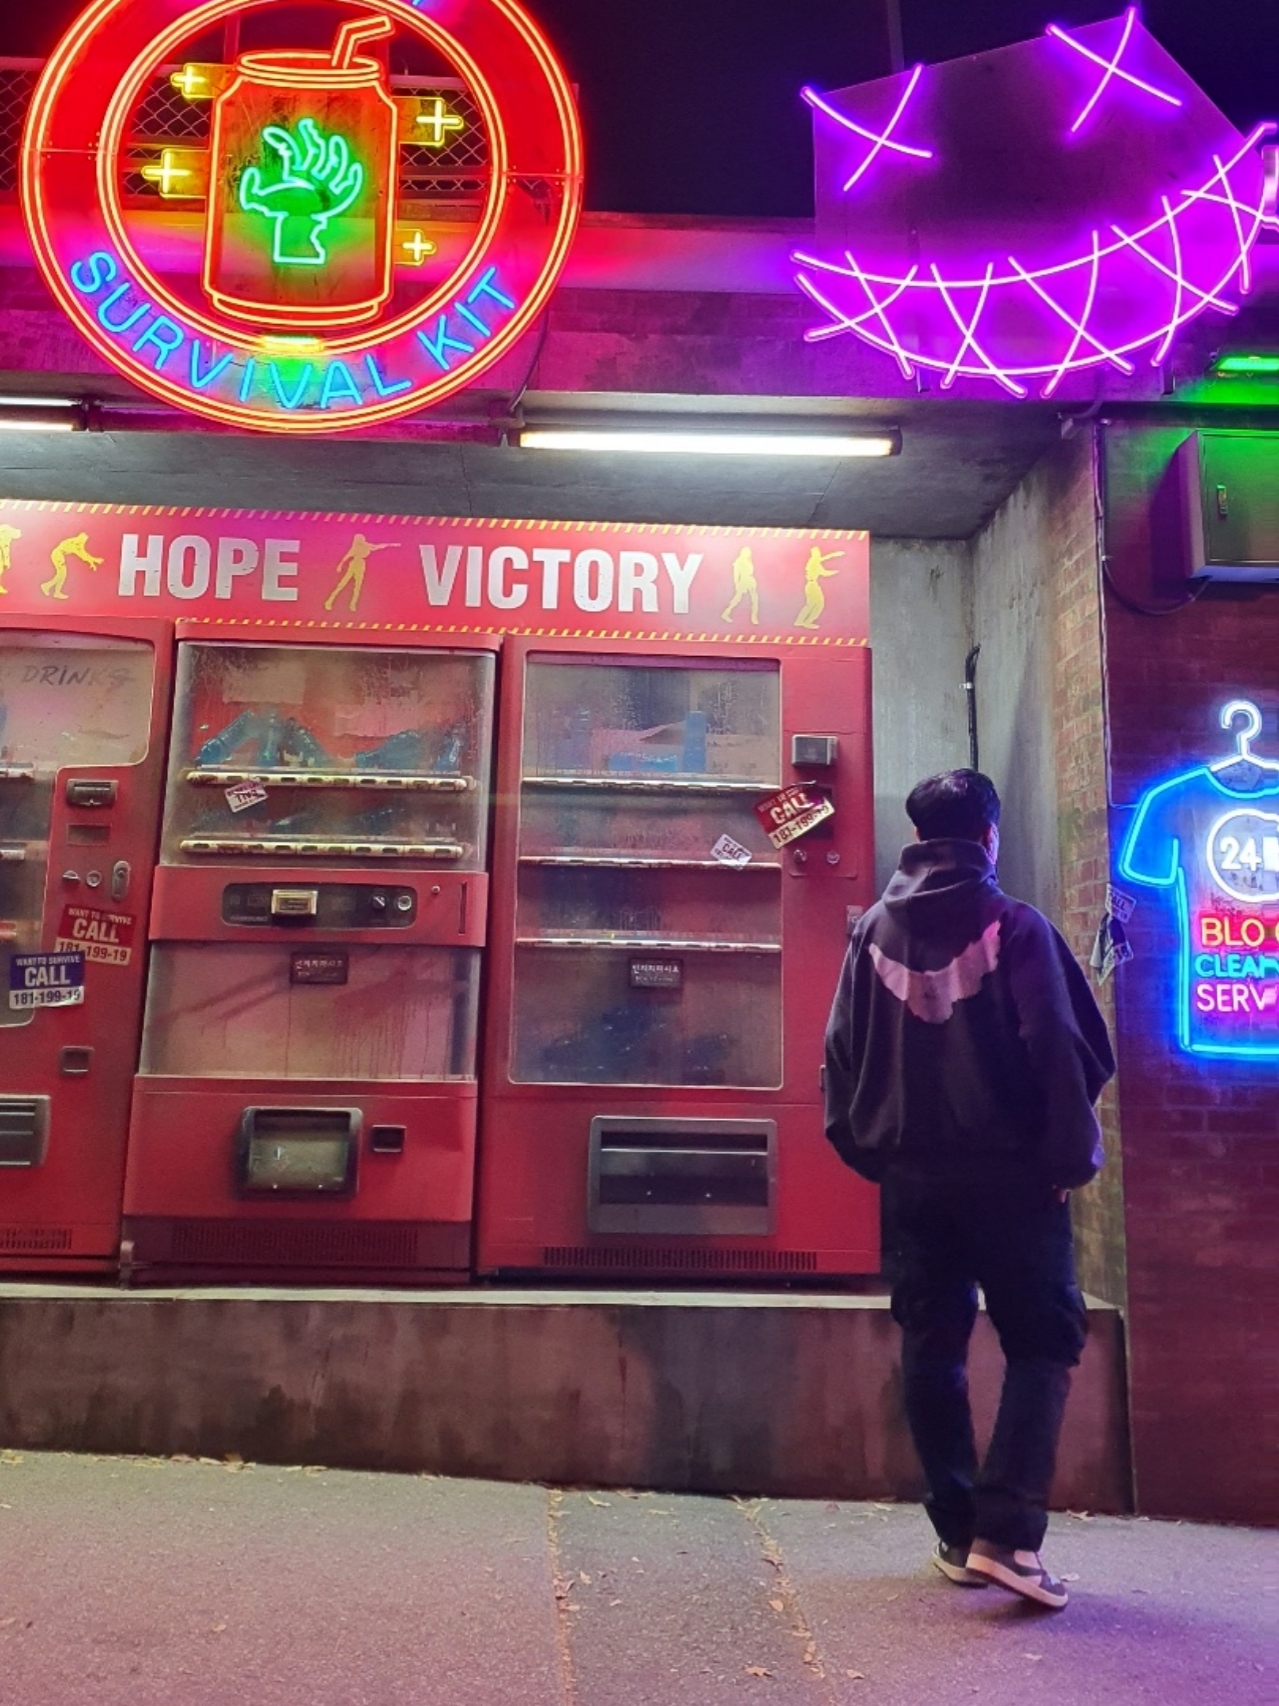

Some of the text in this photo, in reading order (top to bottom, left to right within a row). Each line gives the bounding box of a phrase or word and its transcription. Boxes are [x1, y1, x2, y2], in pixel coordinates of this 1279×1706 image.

[70, 251, 515, 409] SURVIVAL KIT
[118, 533, 704, 614] HOPE VICTORY
[770, 793, 815, 824] CALL
[1219, 836, 1279, 871] 24
[68, 907, 89, 918] WANT
[72, 918, 119, 943] CALL
[1201, 917, 1279, 947] BLO
[16, 954, 80, 966] WANT TO SURVIVE
[59, 941, 128, 962] 181199-19
[24, 965, 71, 987] CALL
[14, 988, 81, 1006] 181-199-19
